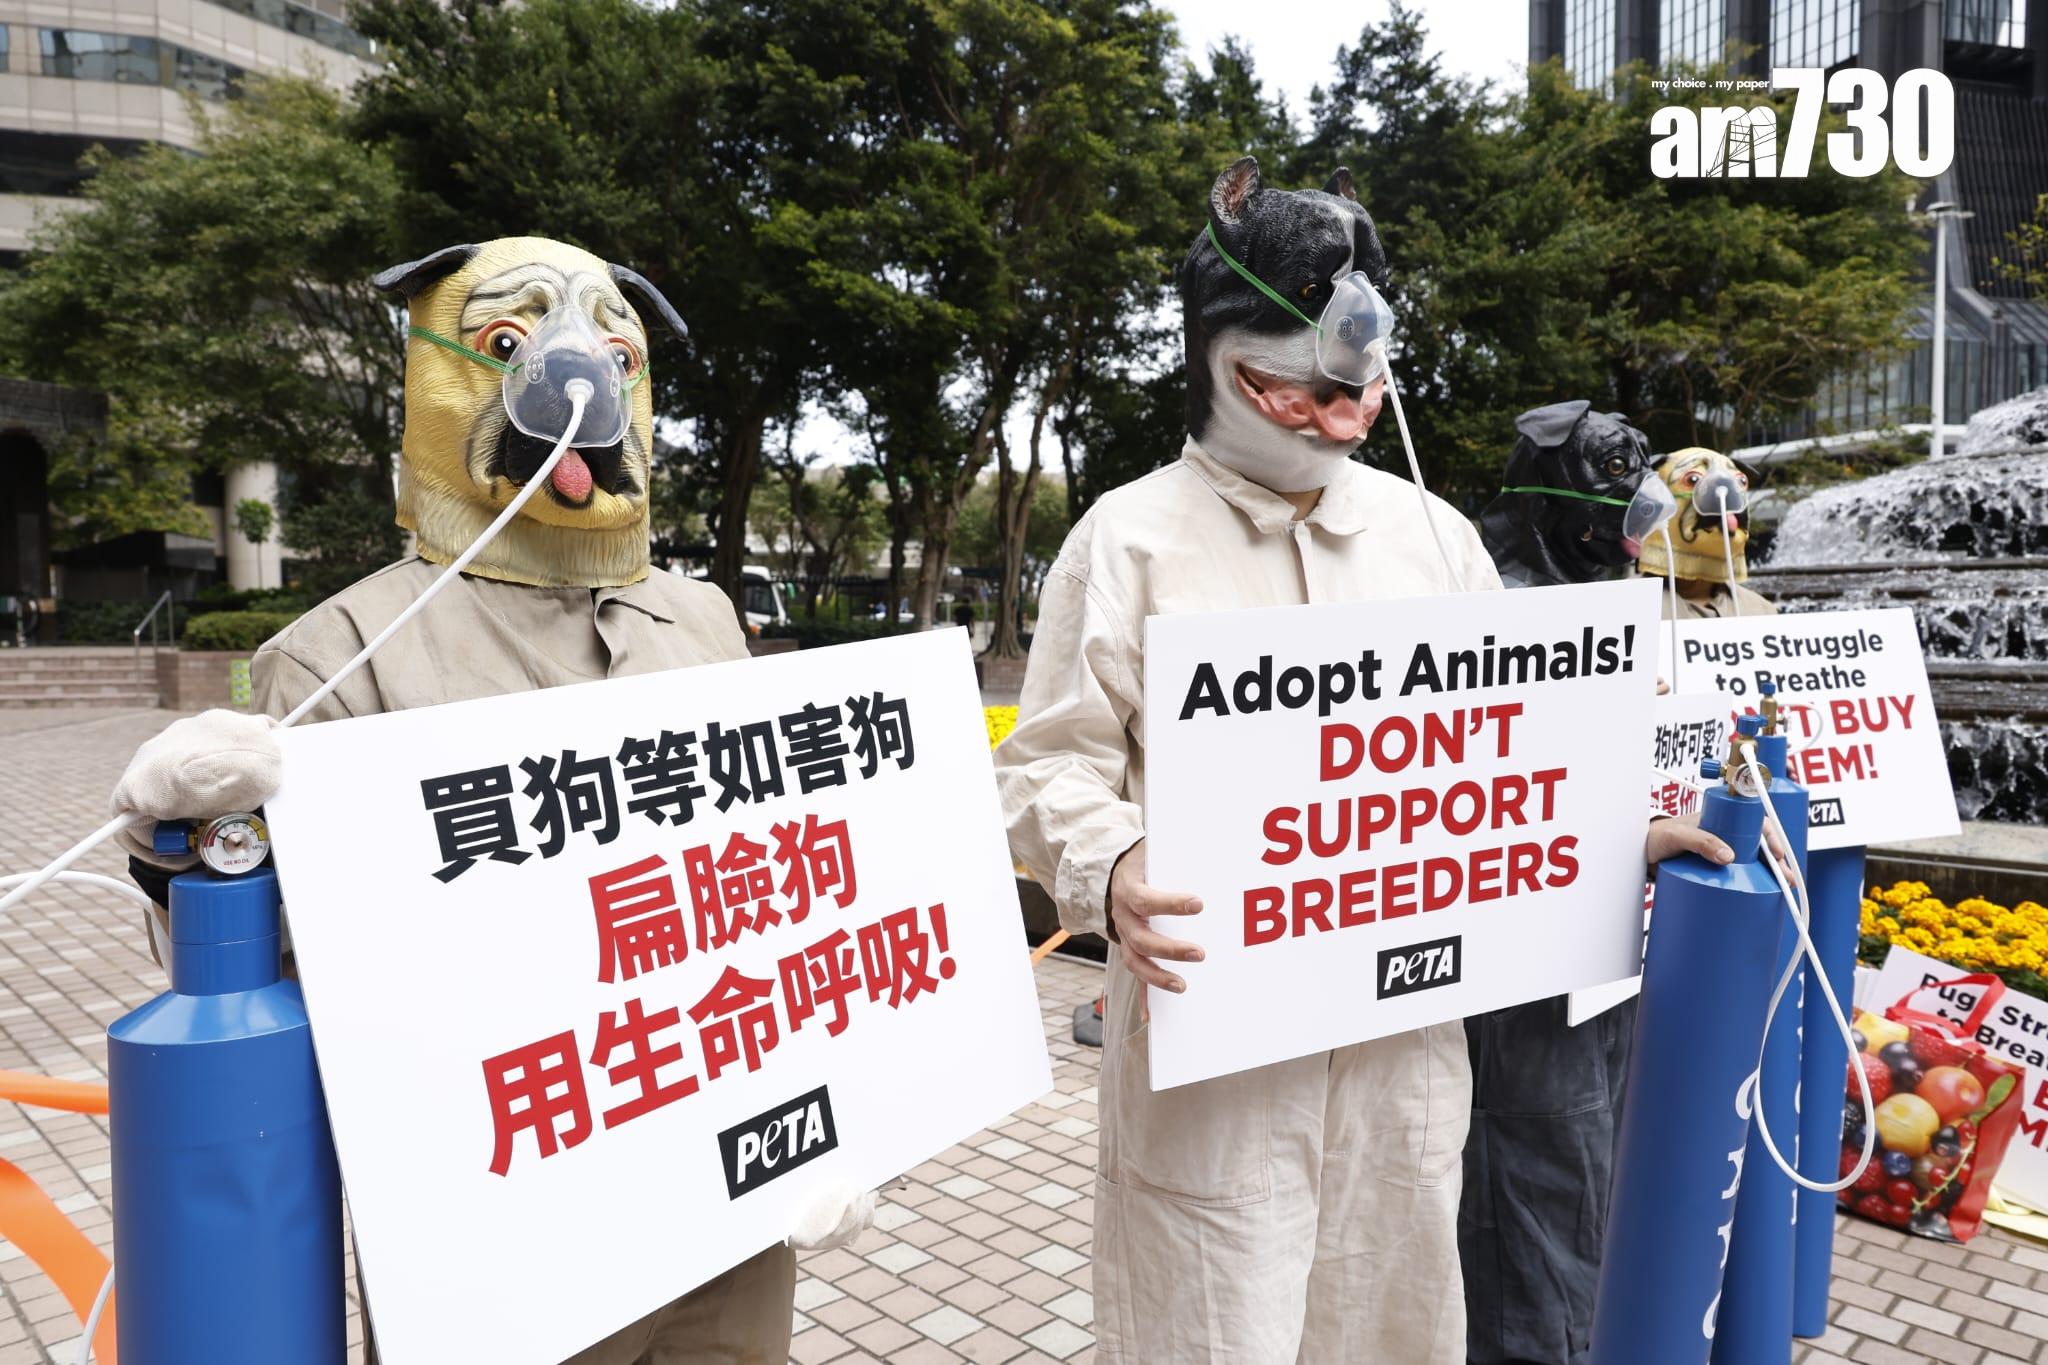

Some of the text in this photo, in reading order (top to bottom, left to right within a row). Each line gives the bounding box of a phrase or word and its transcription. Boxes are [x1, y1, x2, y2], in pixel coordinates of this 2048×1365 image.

[1178, 625, 1636, 721] Adopt Animals!
[1684, 629, 1884, 666] Pugs Struggle
[1716, 665, 1867, 696] to Breathe
[1320, 703, 1523, 782] DON'T
[1830, 694, 1915, 735] BUY
[420, 691, 915, 884] 買狗等如害狗
[1261, 767, 1567, 866] SUPPORT
[588, 814, 857, 984] 扁臉狗
[1243, 835, 1579, 947] BREEDERS
[482, 902, 957, 1178] 用生命呼吸!
